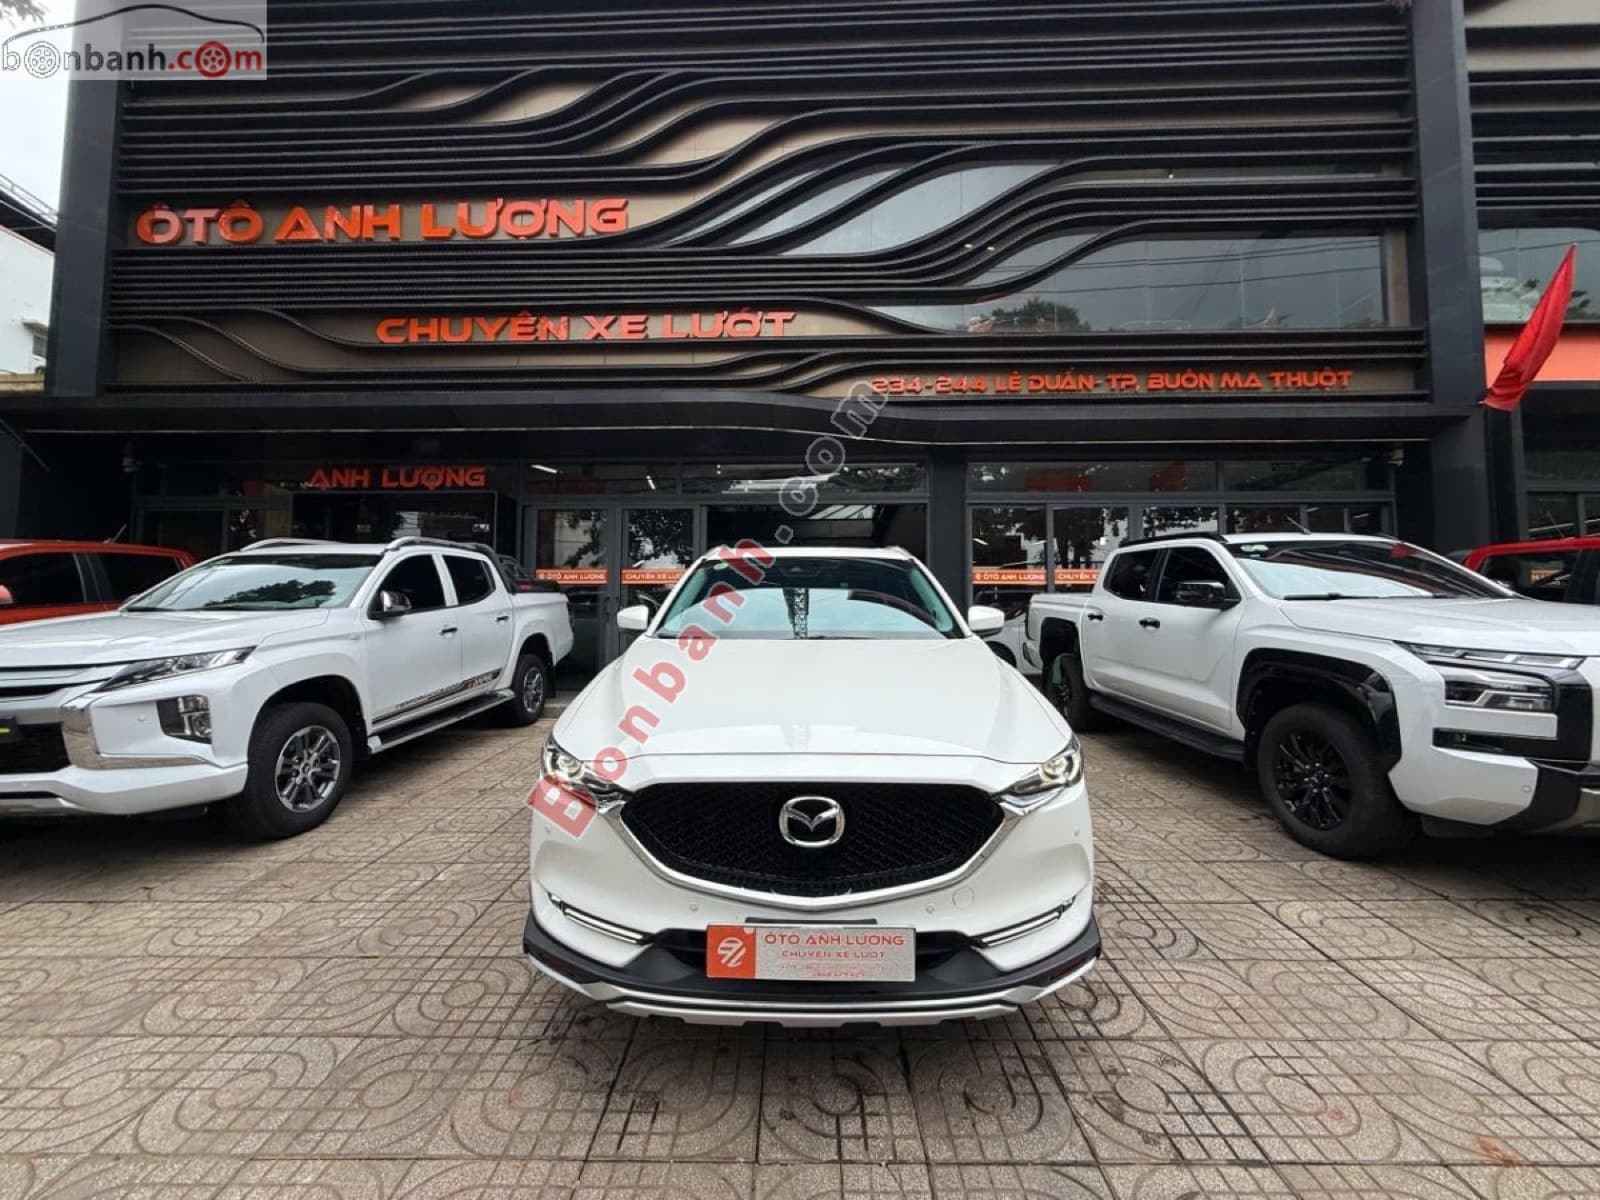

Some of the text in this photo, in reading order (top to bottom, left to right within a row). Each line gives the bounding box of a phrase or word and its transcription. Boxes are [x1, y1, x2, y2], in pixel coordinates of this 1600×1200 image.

[273, 203, 402, 242] ANH
[421, 197, 628, 240] LƯỢNG
[376, 306, 796, 344] CHUYÊN XE LƯỚT
[1219, 372, 1264, 391] MA
[310, 467, 369, 488] ANH
[805, 934, 841, 946] ANH
